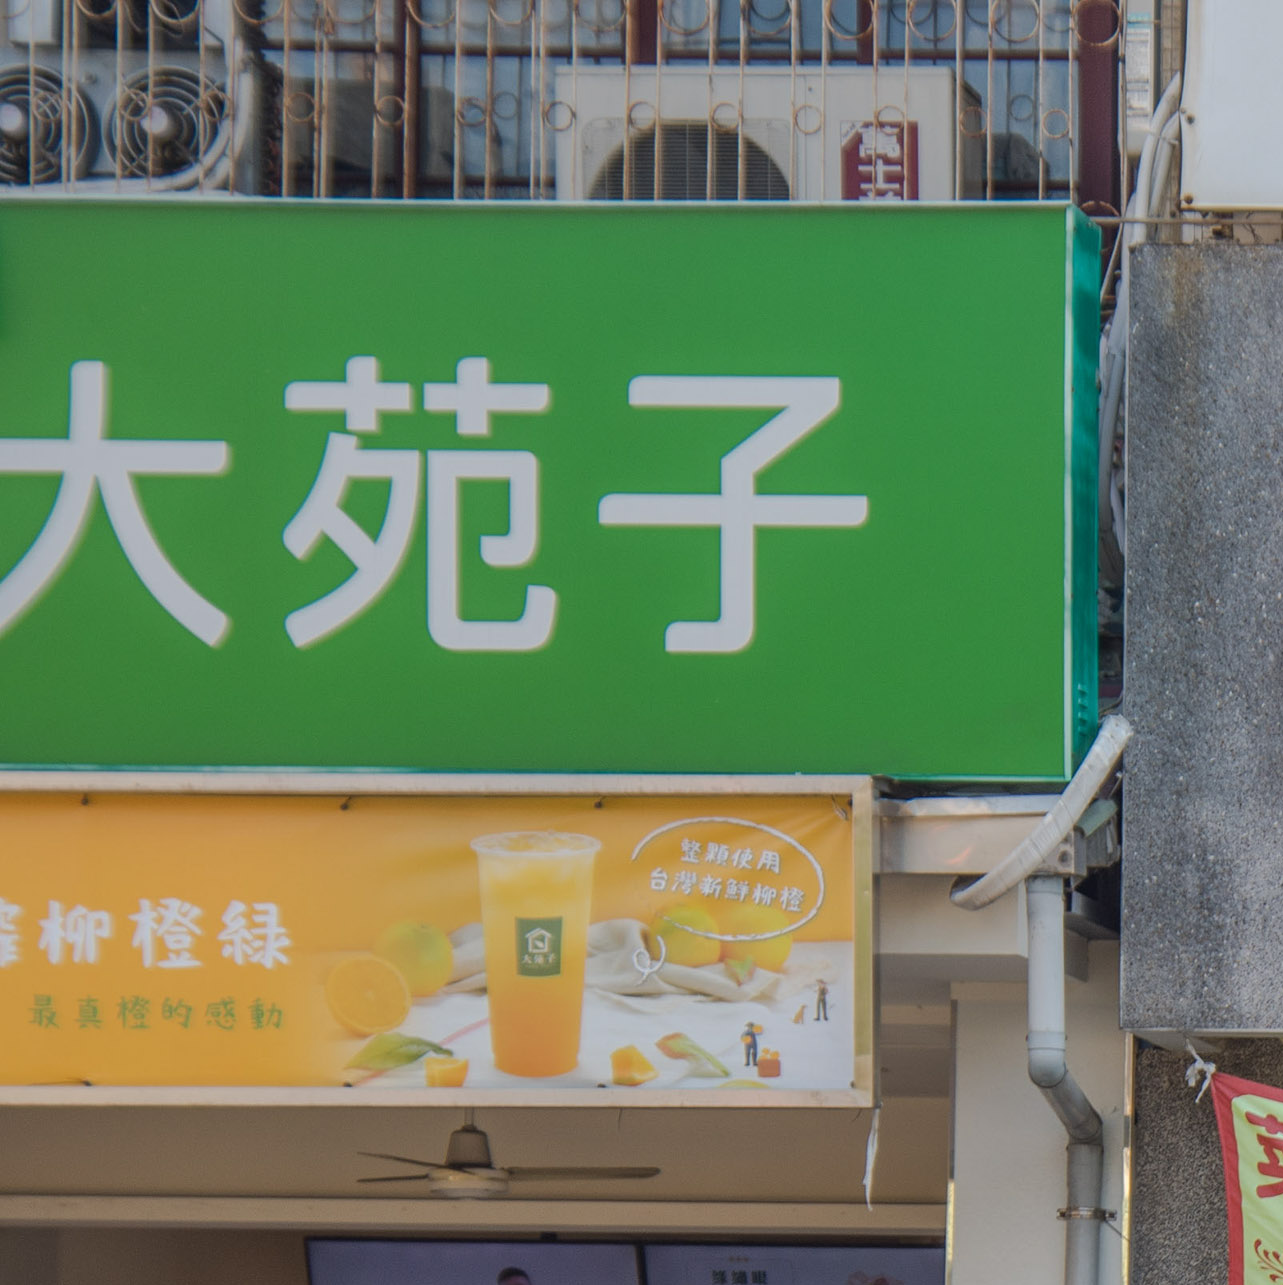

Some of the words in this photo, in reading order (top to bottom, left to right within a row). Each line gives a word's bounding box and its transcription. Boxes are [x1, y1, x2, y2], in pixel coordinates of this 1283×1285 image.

[858, 125, 902, 200] 富士
[0, 357, 869, 652] 大苑子
[680, 837, 781, 875] 整顆使用
[650, 867, 805, 912] 台灣新鮮柳橙
[29, 994, 283, 1030] 最真橙的感動
